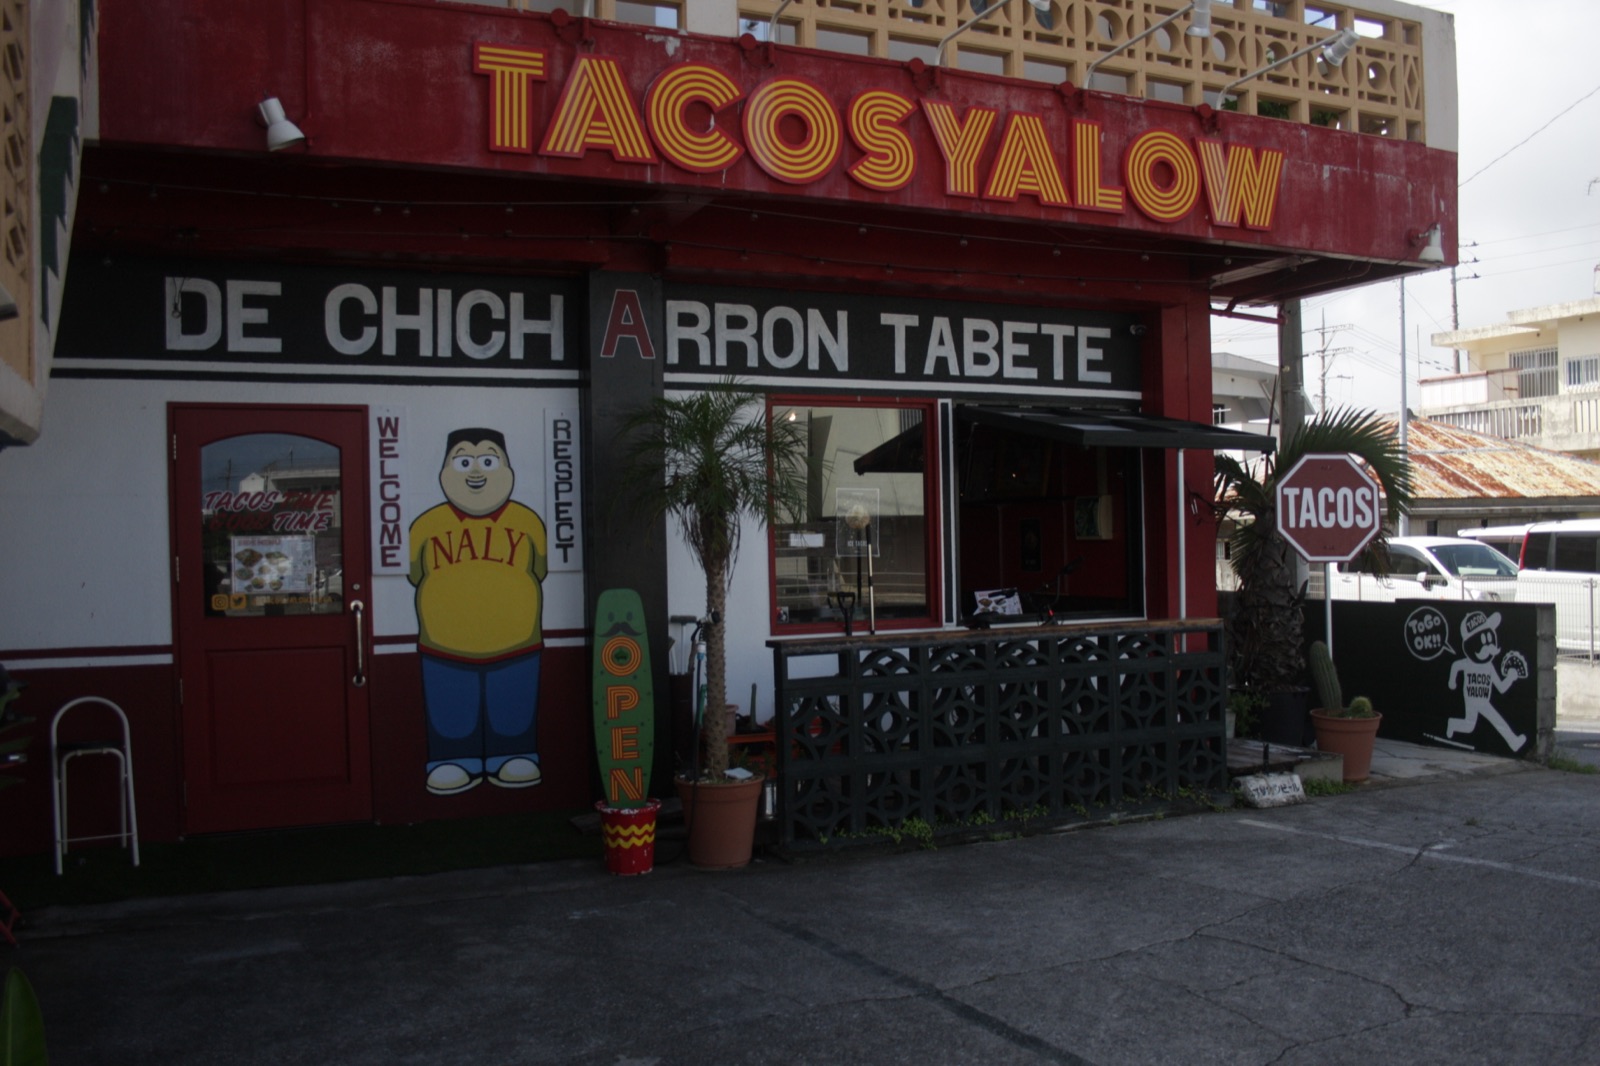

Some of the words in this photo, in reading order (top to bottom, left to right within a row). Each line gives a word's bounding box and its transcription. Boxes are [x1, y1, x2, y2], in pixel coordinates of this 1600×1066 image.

[165, 276, 283, 353] DE
[880, 312, 1112, 384] TABETE
[204, 491, 280, 512] TACOS
[377, 416, 402, 567] WELCOME
[553, 419, 575, 563] RESPECT
[272, 510, 333, 532] TIME
[1282, 486, 1373, 529] TACOS
[431, 526, 526, 570] NALY
[1466, 614, 1487, 631] TACOS
[1413, 634, 1441, 651] OK!!
[1466, 686, 1490, 699] YALOW
[1467, 673, 1491, 686] TACOS
[601, 635, 644, 802] OPEN
